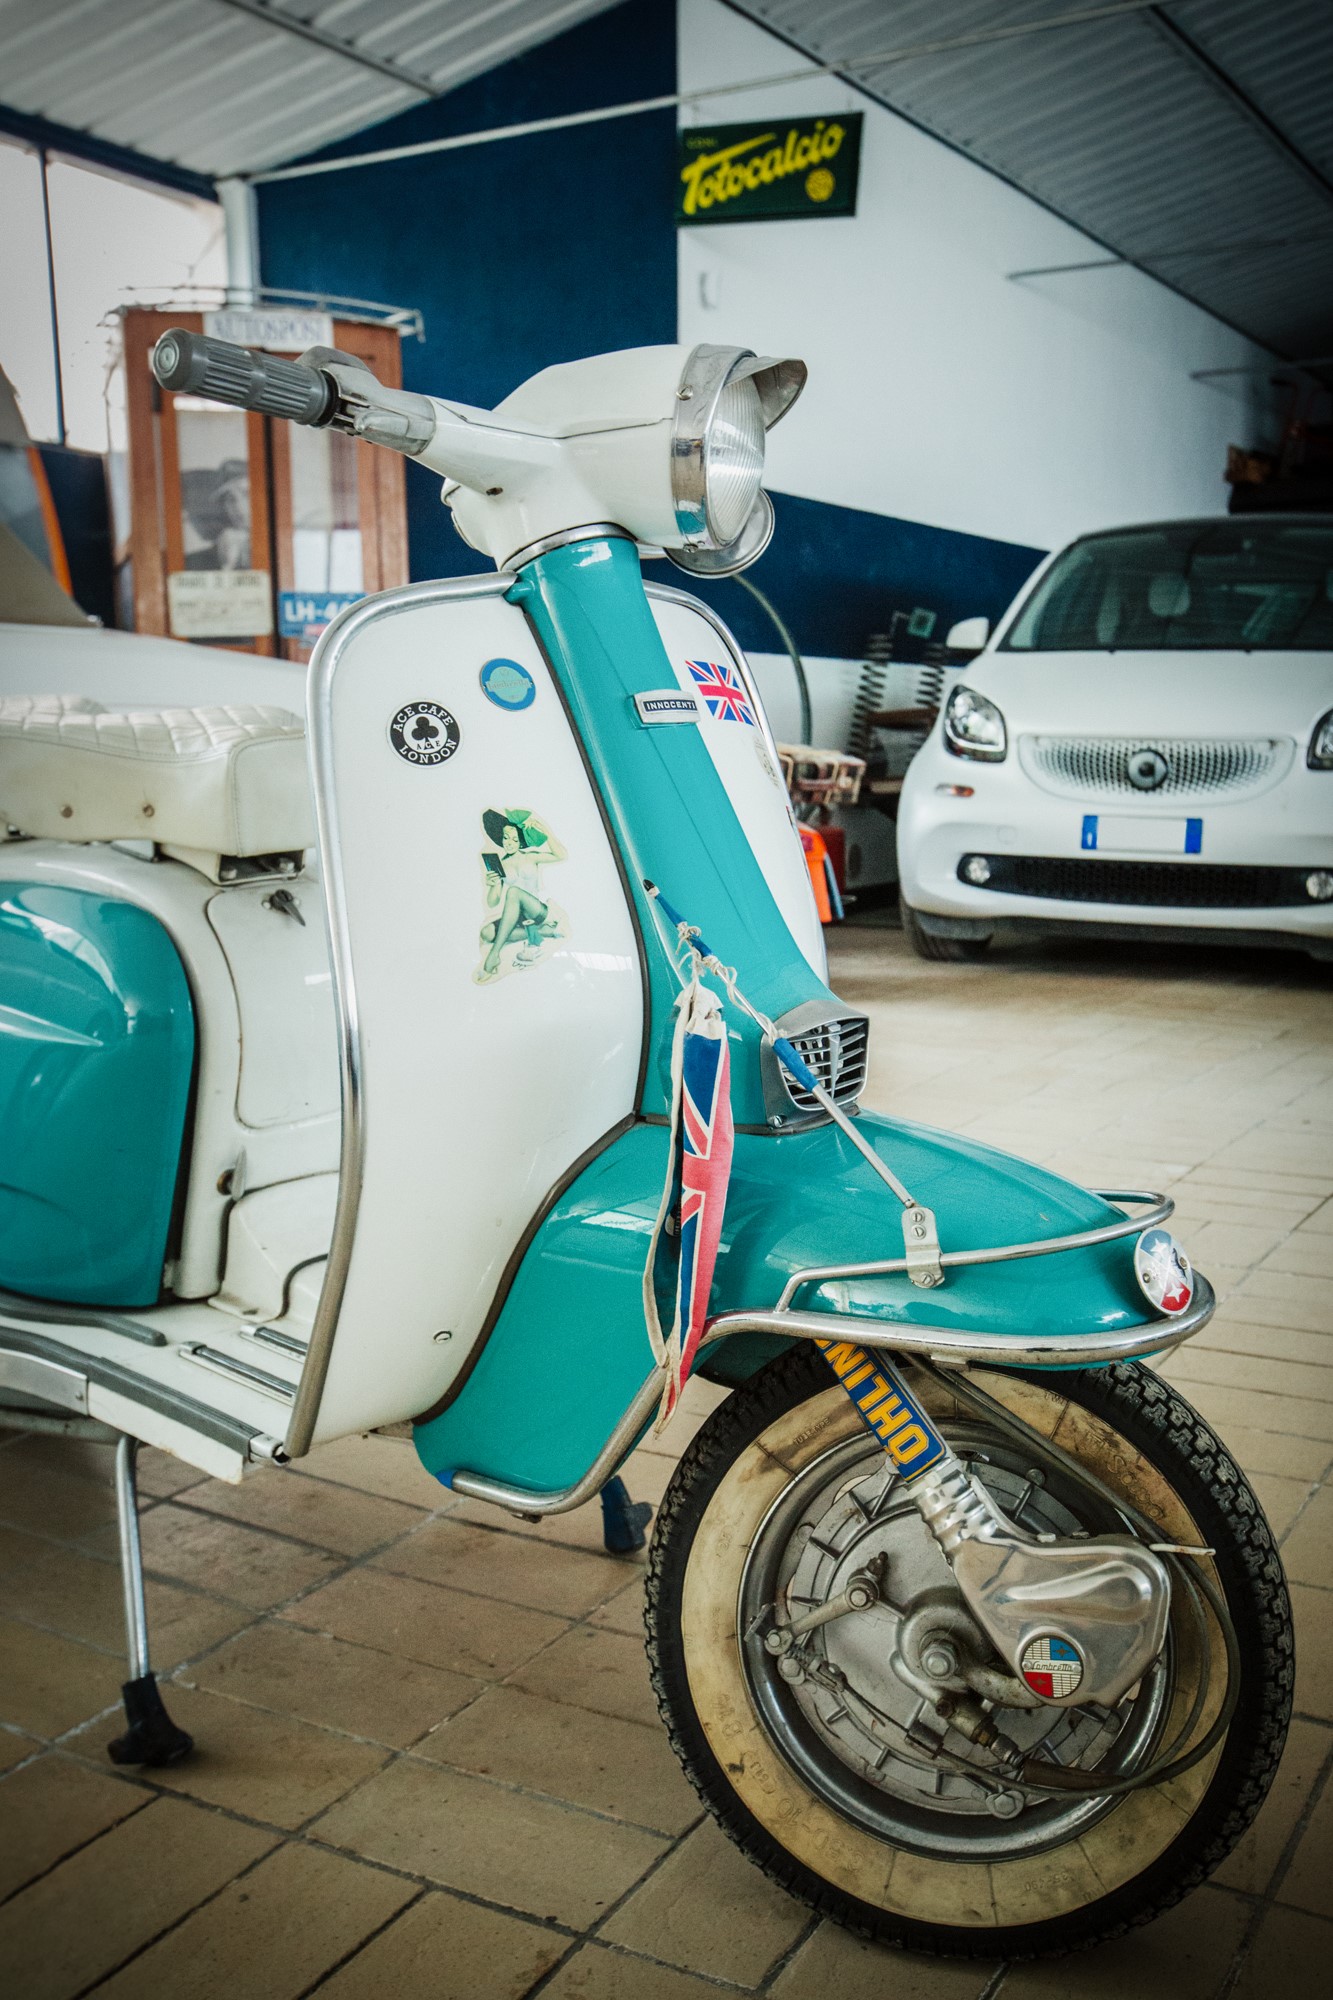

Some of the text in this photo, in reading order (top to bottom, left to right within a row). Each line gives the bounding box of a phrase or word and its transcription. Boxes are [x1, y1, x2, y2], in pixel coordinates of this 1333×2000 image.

[681, 120, 845, 215] Totocalcio
[646, 700, 697, 710] INNOCENTI
[393, 703, 454, 733] ACE CAFE
[399, 738, 457, 764] LONDON
[810, 1417, 831, 1434] TYPE
[1031, 1661, 1072, 1671] Lambretta
